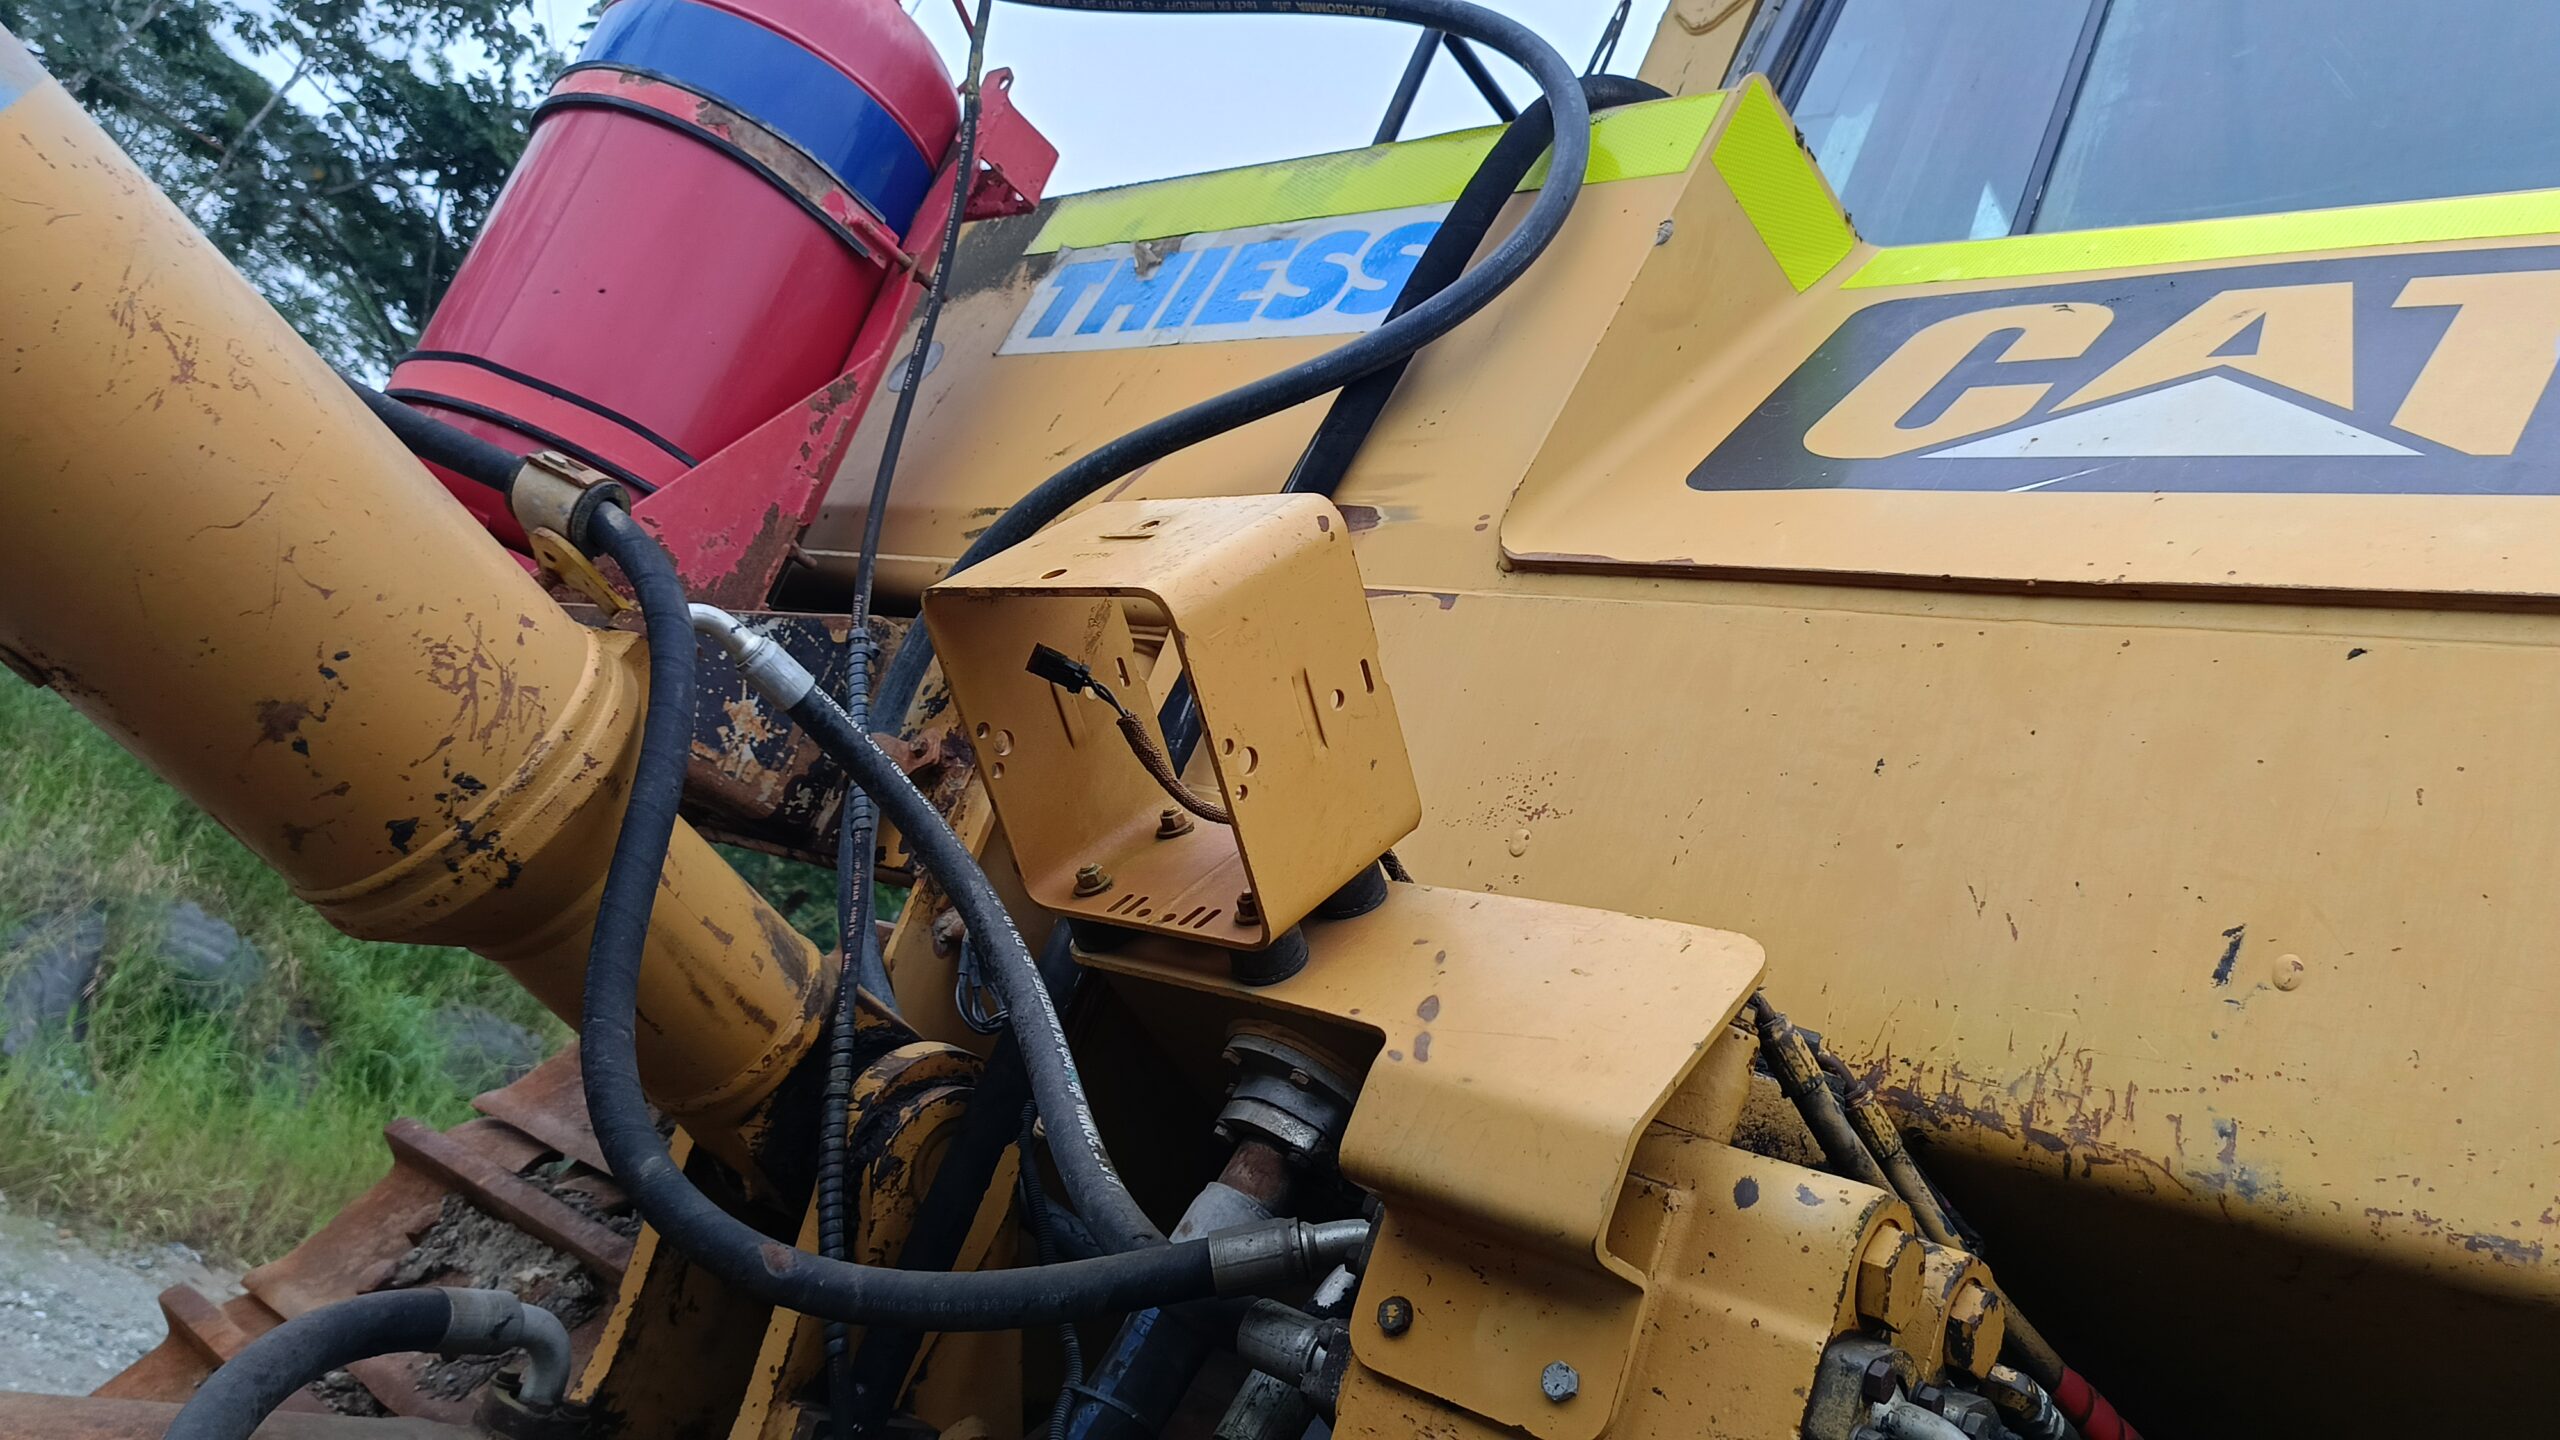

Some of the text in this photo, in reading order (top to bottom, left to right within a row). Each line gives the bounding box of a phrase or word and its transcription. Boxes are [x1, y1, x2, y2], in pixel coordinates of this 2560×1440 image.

[1294, 1, 1375, 16] ALFAGOMMA
[1027, 221, 1442, 338] THIESS
[1803, 271, 2560, 458] CAT
[1032, 975, 1062, 1031] MINETUFF
